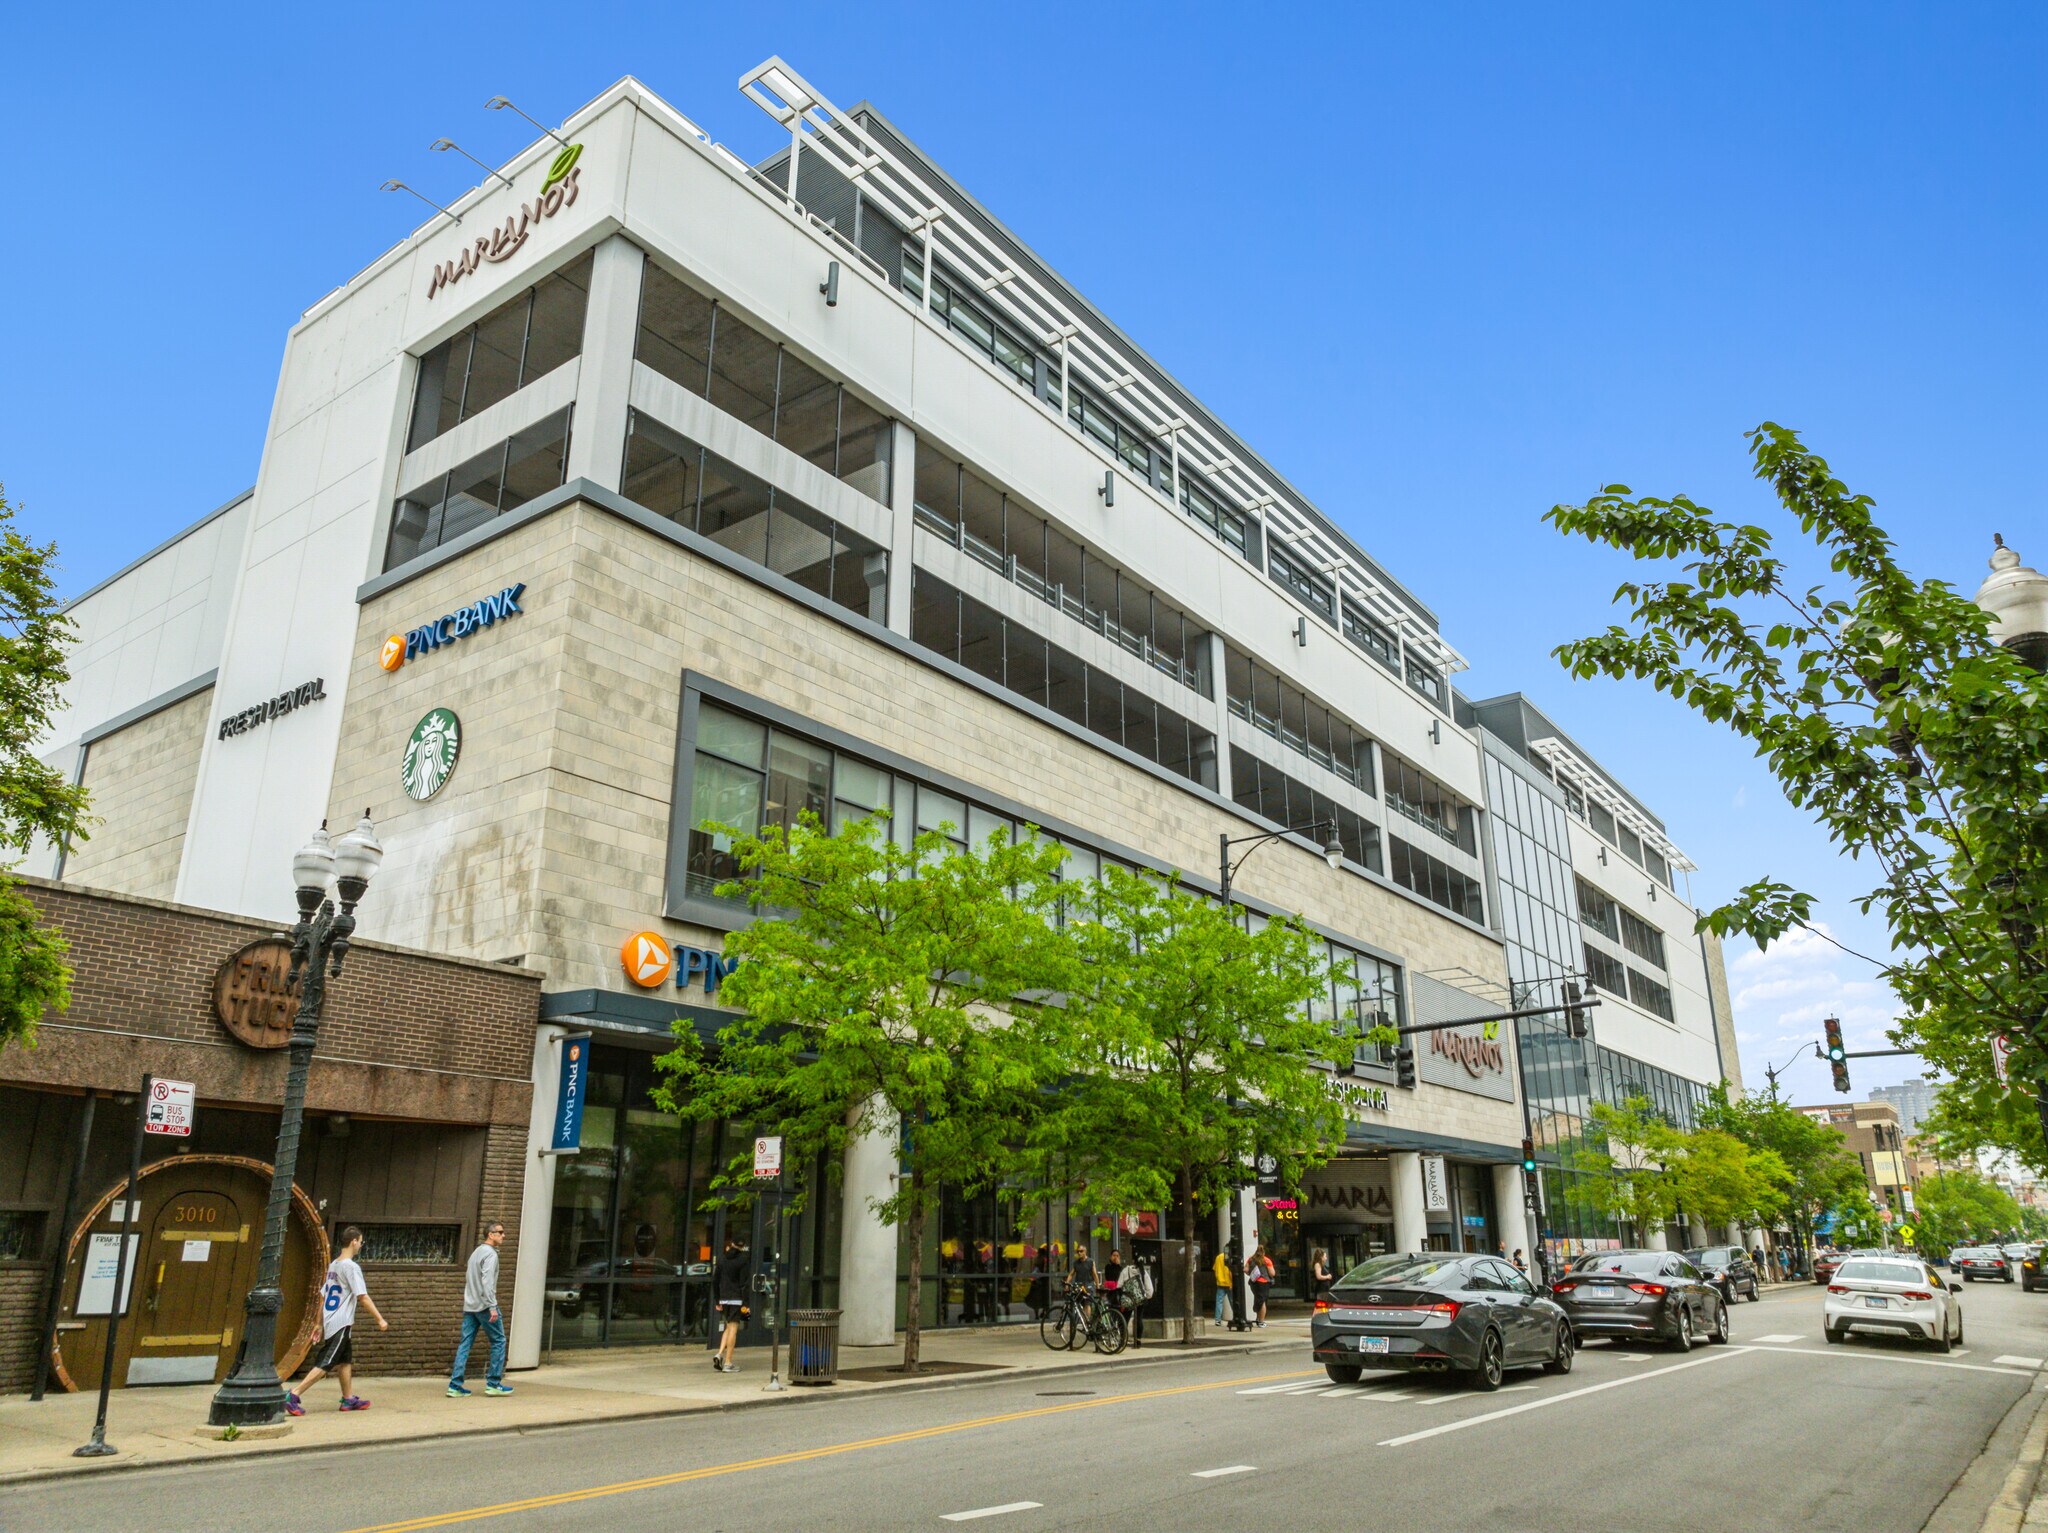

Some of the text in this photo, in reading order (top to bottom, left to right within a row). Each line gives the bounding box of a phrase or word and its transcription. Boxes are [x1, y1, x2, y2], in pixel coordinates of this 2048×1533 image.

[404, 582, 527, 660] PNC BANK
[218, 677, 327, 741] FRESH DENTAL
[674, 944, 739, 993] PN
[167, 1106, 183, 1115] BUS
[562, 1062, 579, 1141] PNC BANK
[149, 1124, 164, 1132] TOW
[166, 1115, 186, 1124] STOP
[175, 1206, 216, 1223] 3010
[1311, 1184, 1393, 1217] MARIA
